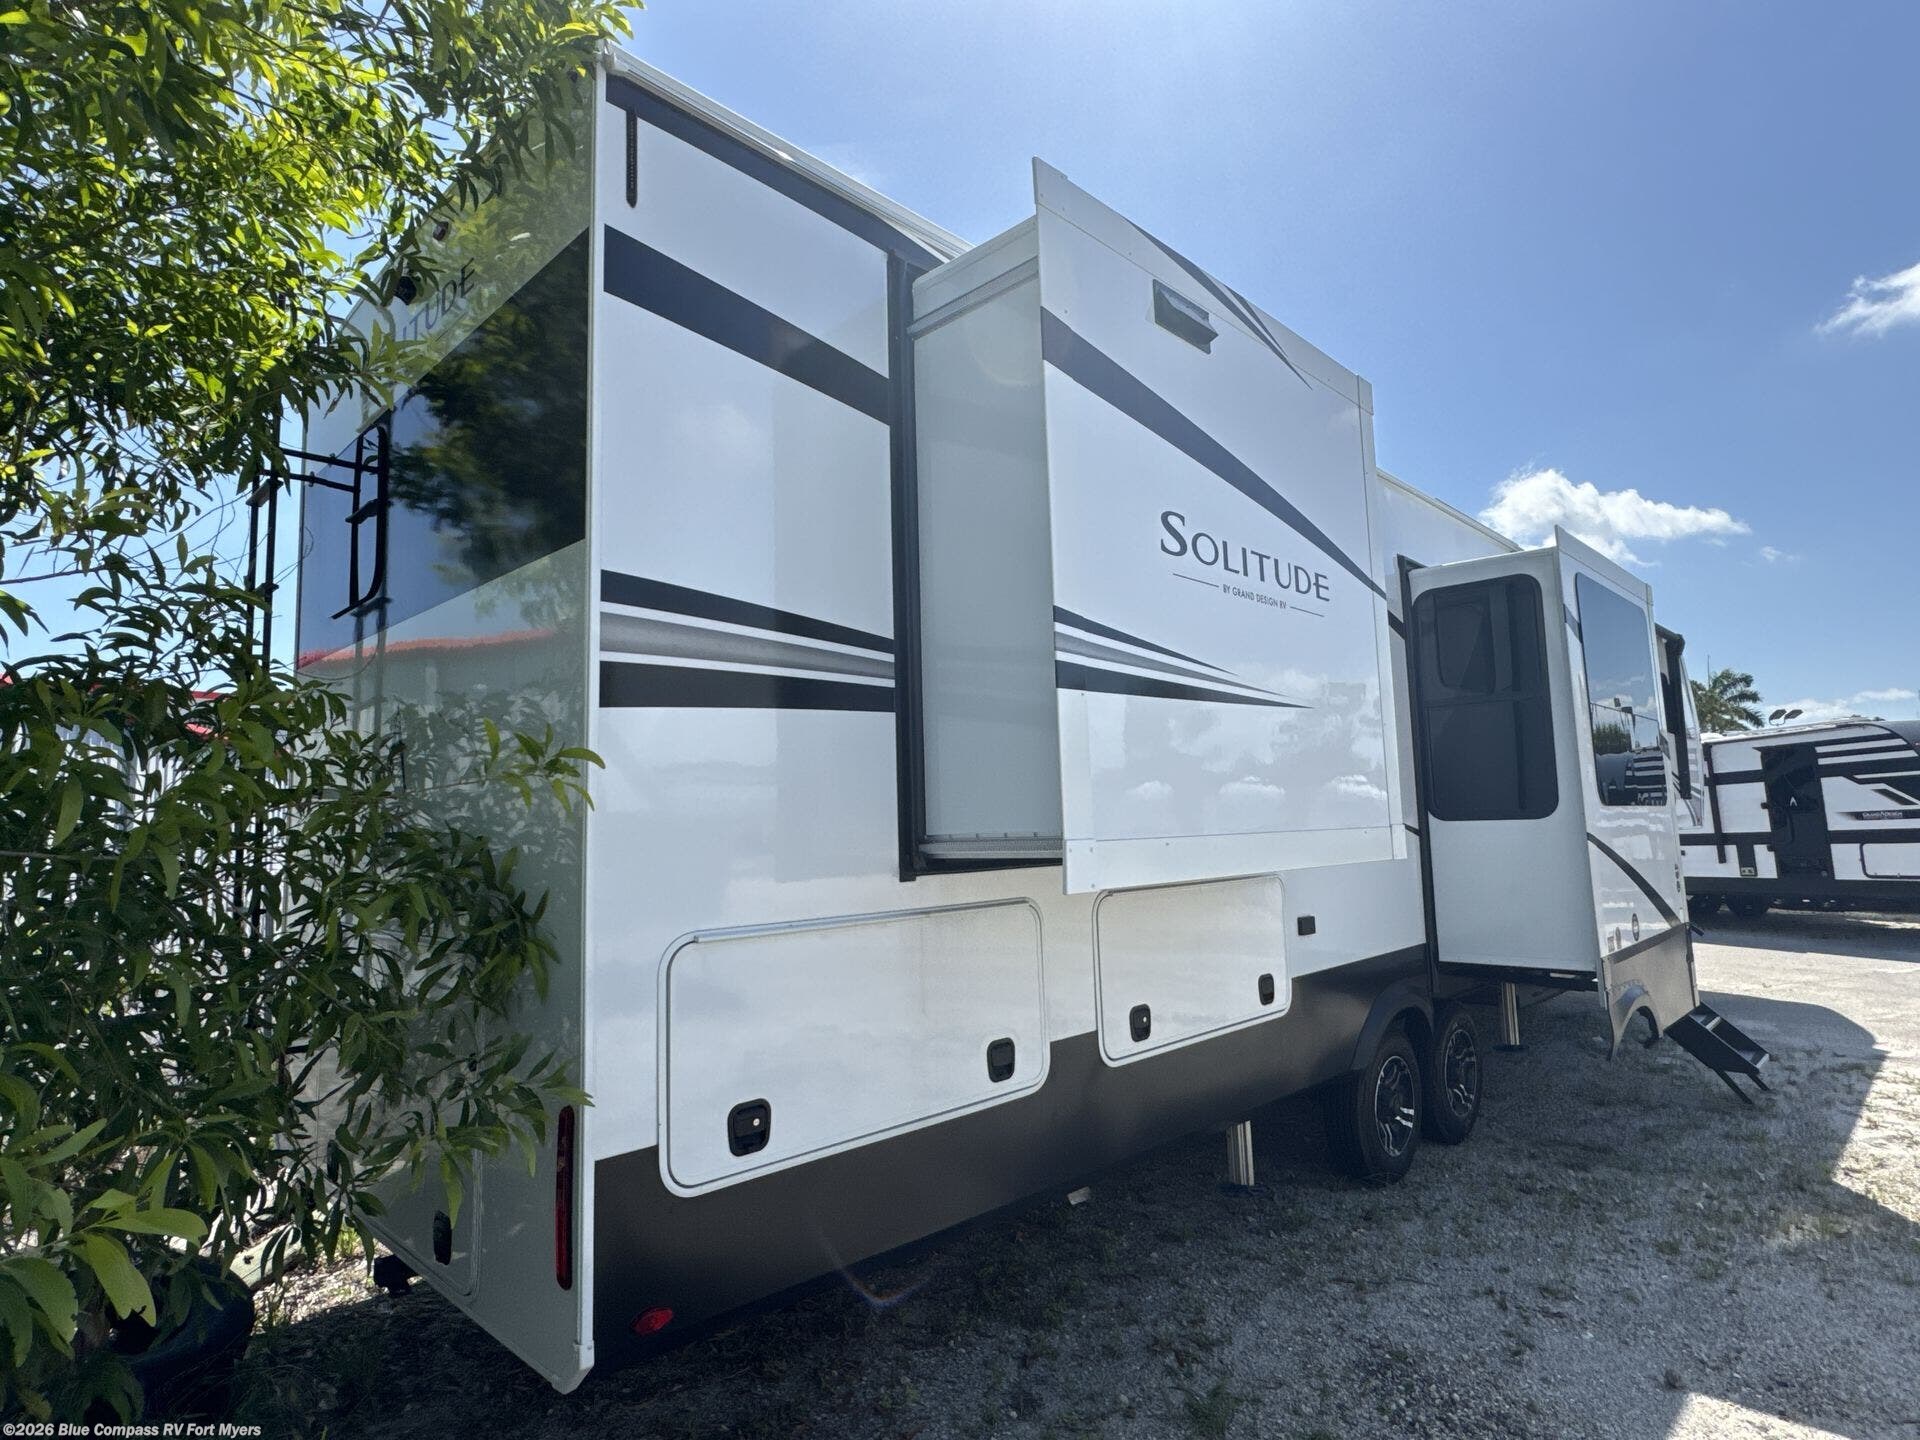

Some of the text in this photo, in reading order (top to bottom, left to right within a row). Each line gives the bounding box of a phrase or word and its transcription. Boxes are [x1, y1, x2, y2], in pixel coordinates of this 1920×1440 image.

[1222, 584, 1287, 609] BY GRAND DESIGN RV
